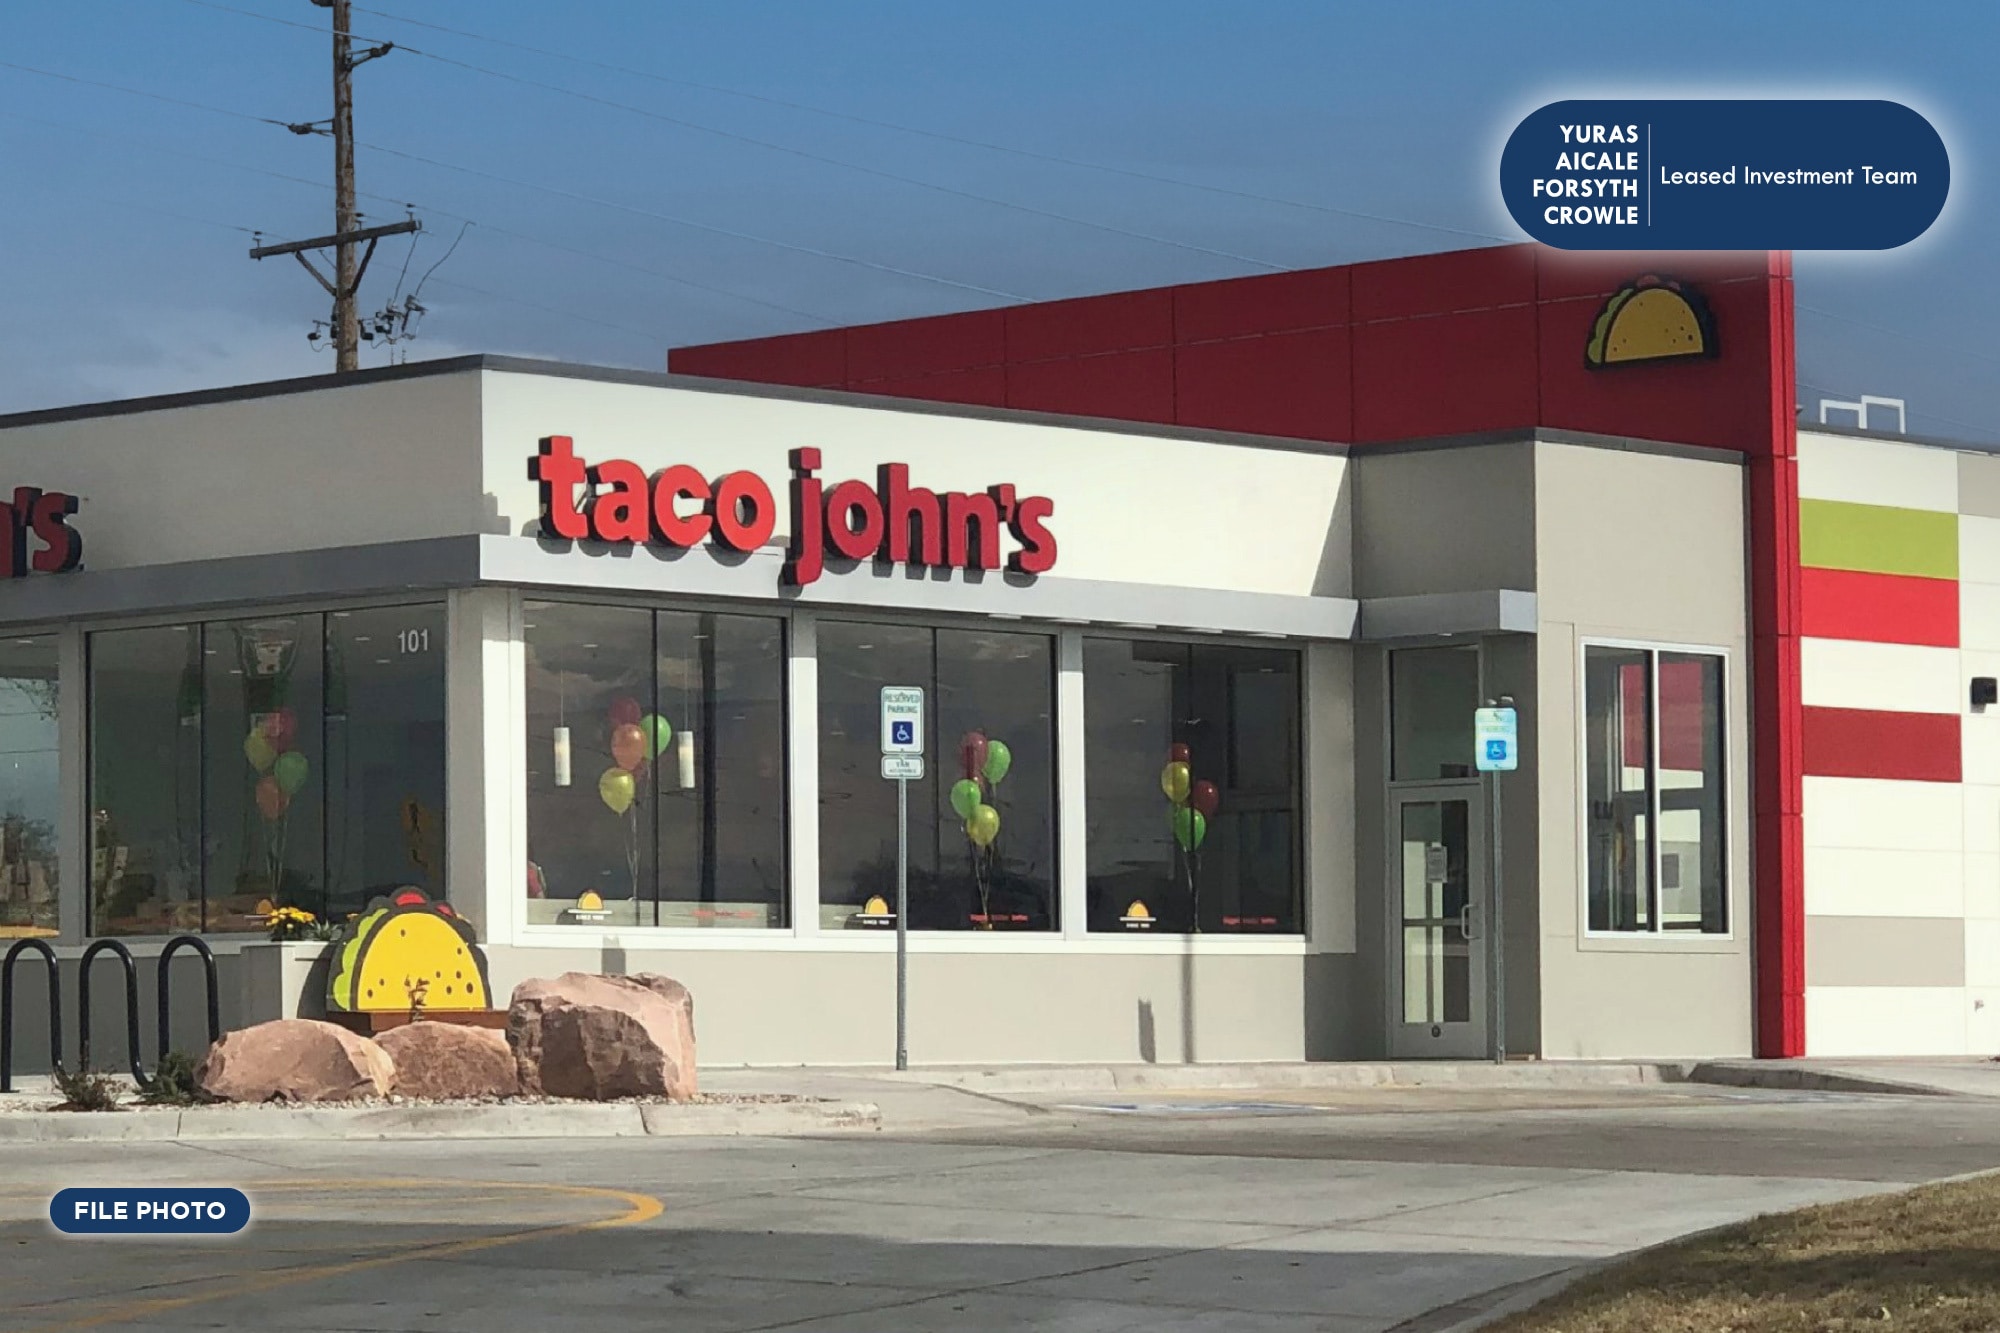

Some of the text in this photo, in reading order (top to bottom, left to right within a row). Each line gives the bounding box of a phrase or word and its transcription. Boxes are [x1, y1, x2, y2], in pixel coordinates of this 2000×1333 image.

[528, 435, 1058, 586] taco john's
[397, 628, 428, 654] 101
[884, 693, 920, 703] RESERVED
[888, 705, 918, 713] PARKING
